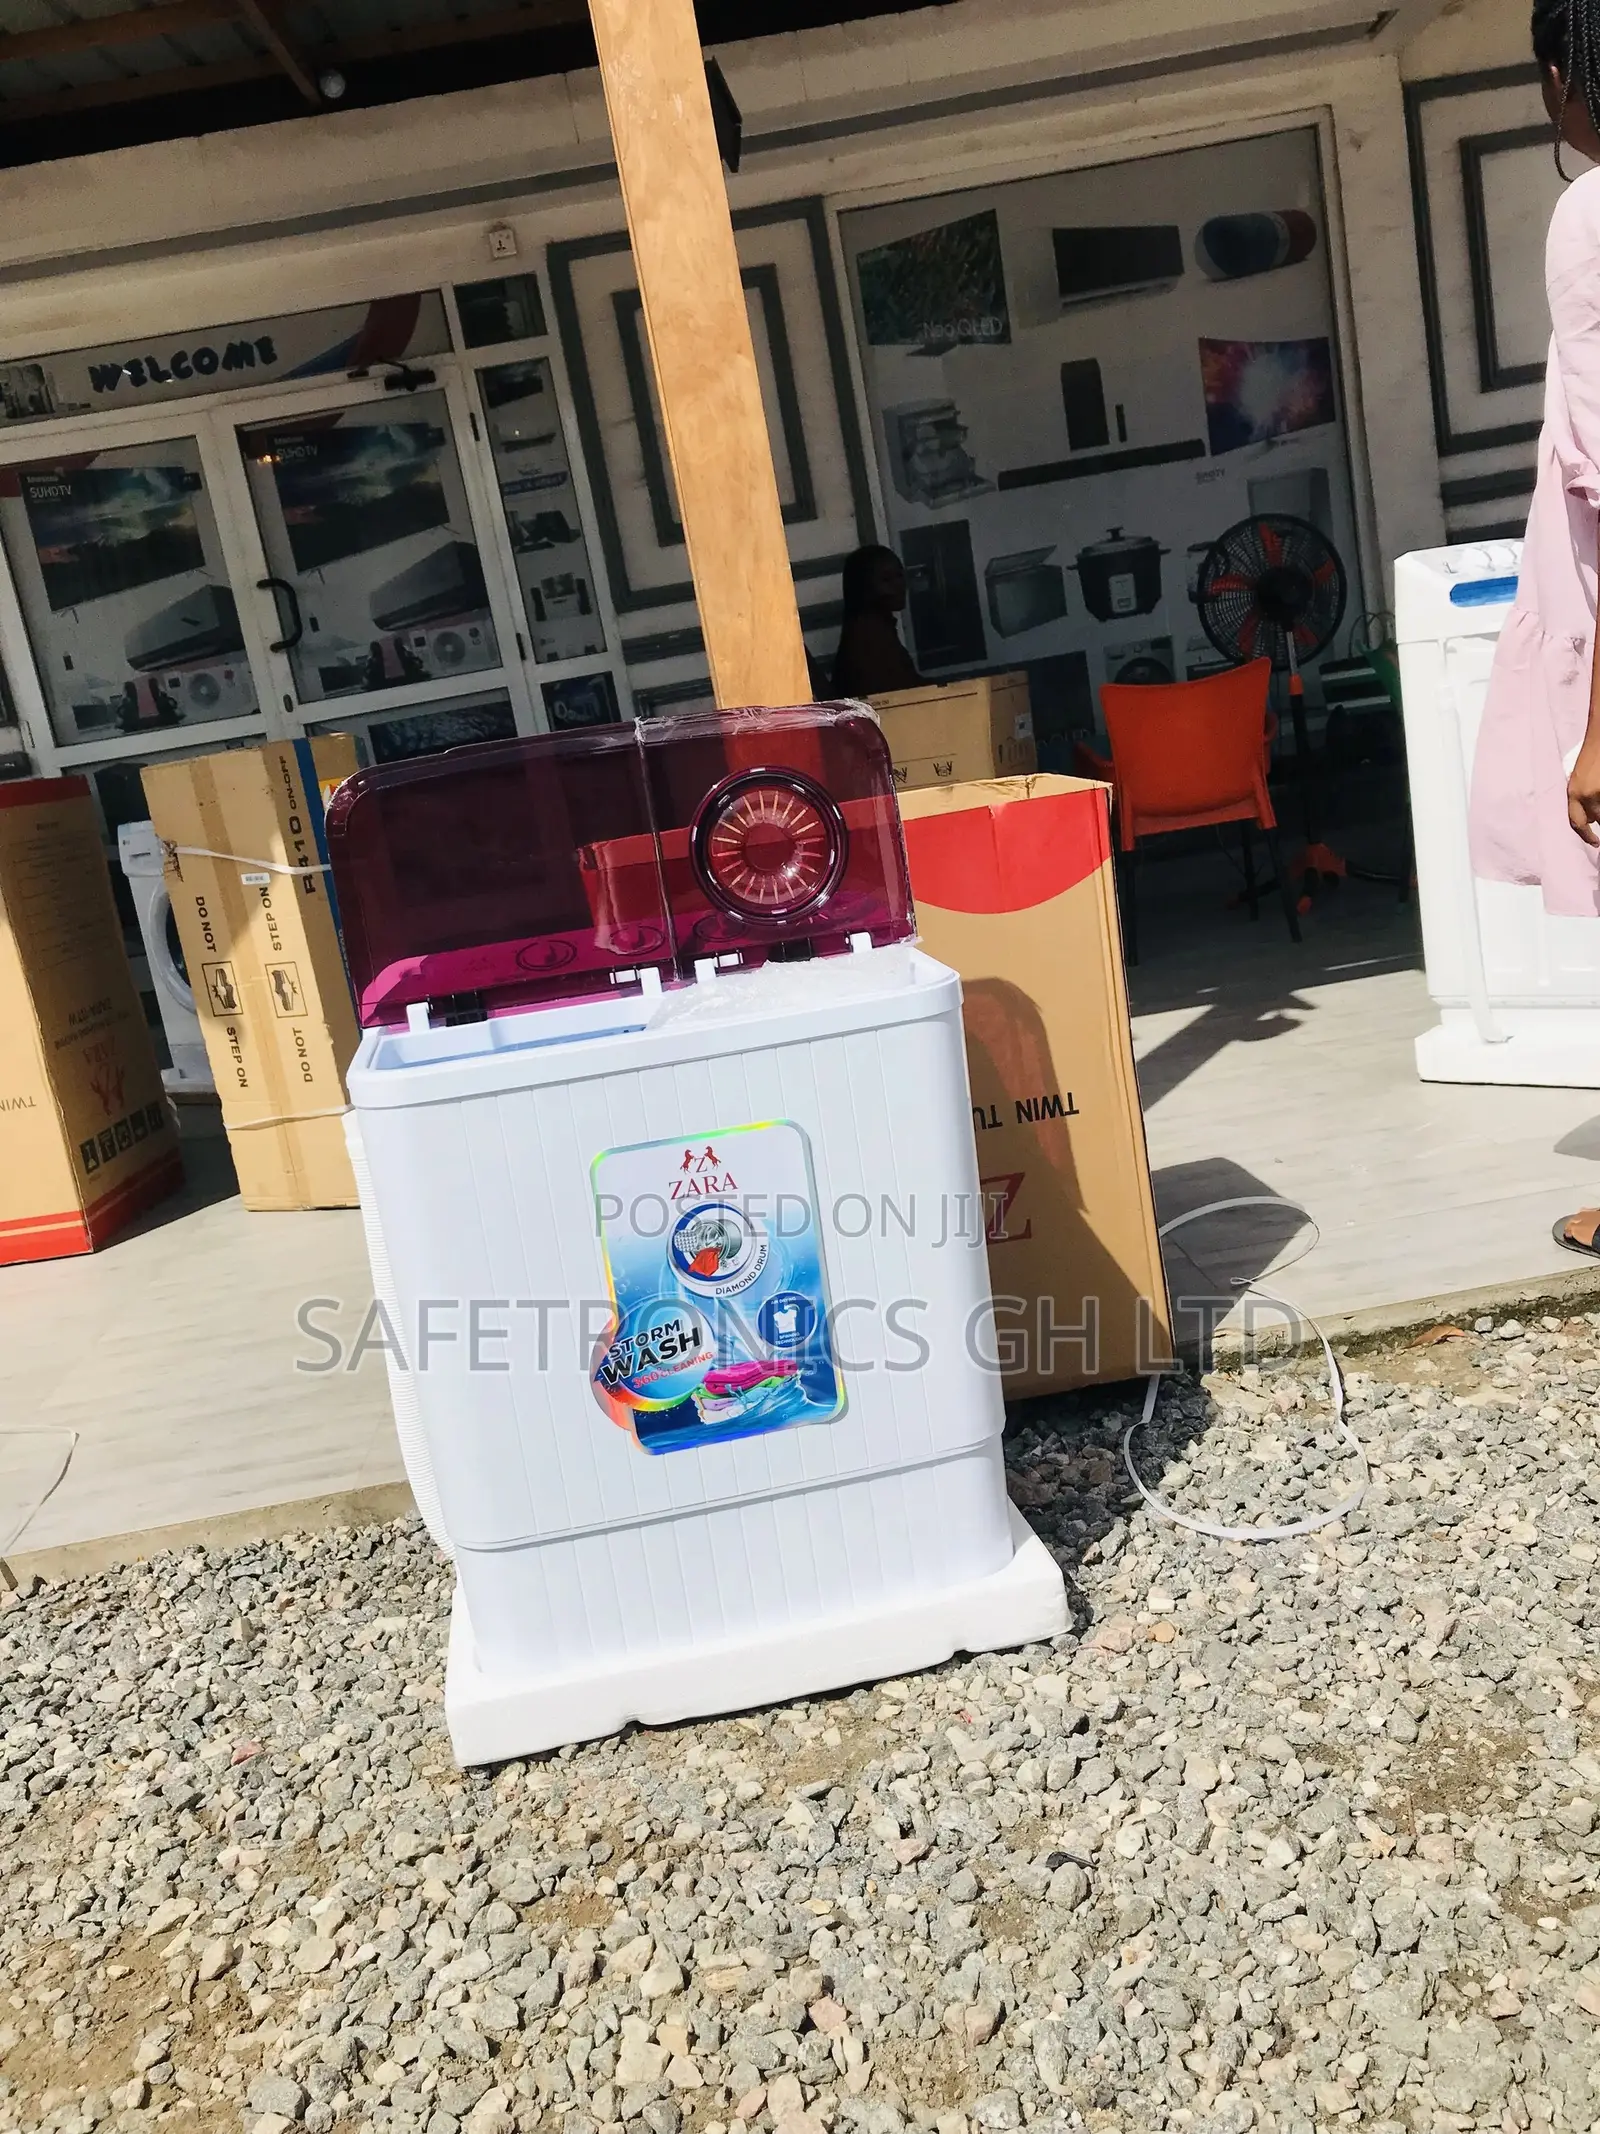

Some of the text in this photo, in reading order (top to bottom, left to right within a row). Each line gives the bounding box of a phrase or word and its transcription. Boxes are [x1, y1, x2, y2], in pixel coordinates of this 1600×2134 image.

[957, 316, 1003, 337] QLED
[88, 336, 277, 393] WELCOME
[279, 755, 316, 894] R410 ON-OFF
[195, 896, 217, 952] DO NOT
[259, 887, 282, 951] STEP ON
[226, 1027, 249, 1088] STEP ON
[292, 1027, 313, 1082] DO NOT
[1015, 1092, 1079, 1124] TWIN
[668, 1172, 739, 1200] ZARA
[715, 1244, 767, 1296] DIAMOND DRUM
[601, 1327, 701, 1385] WASH
[608, 1319, 681, 1359] STORM
